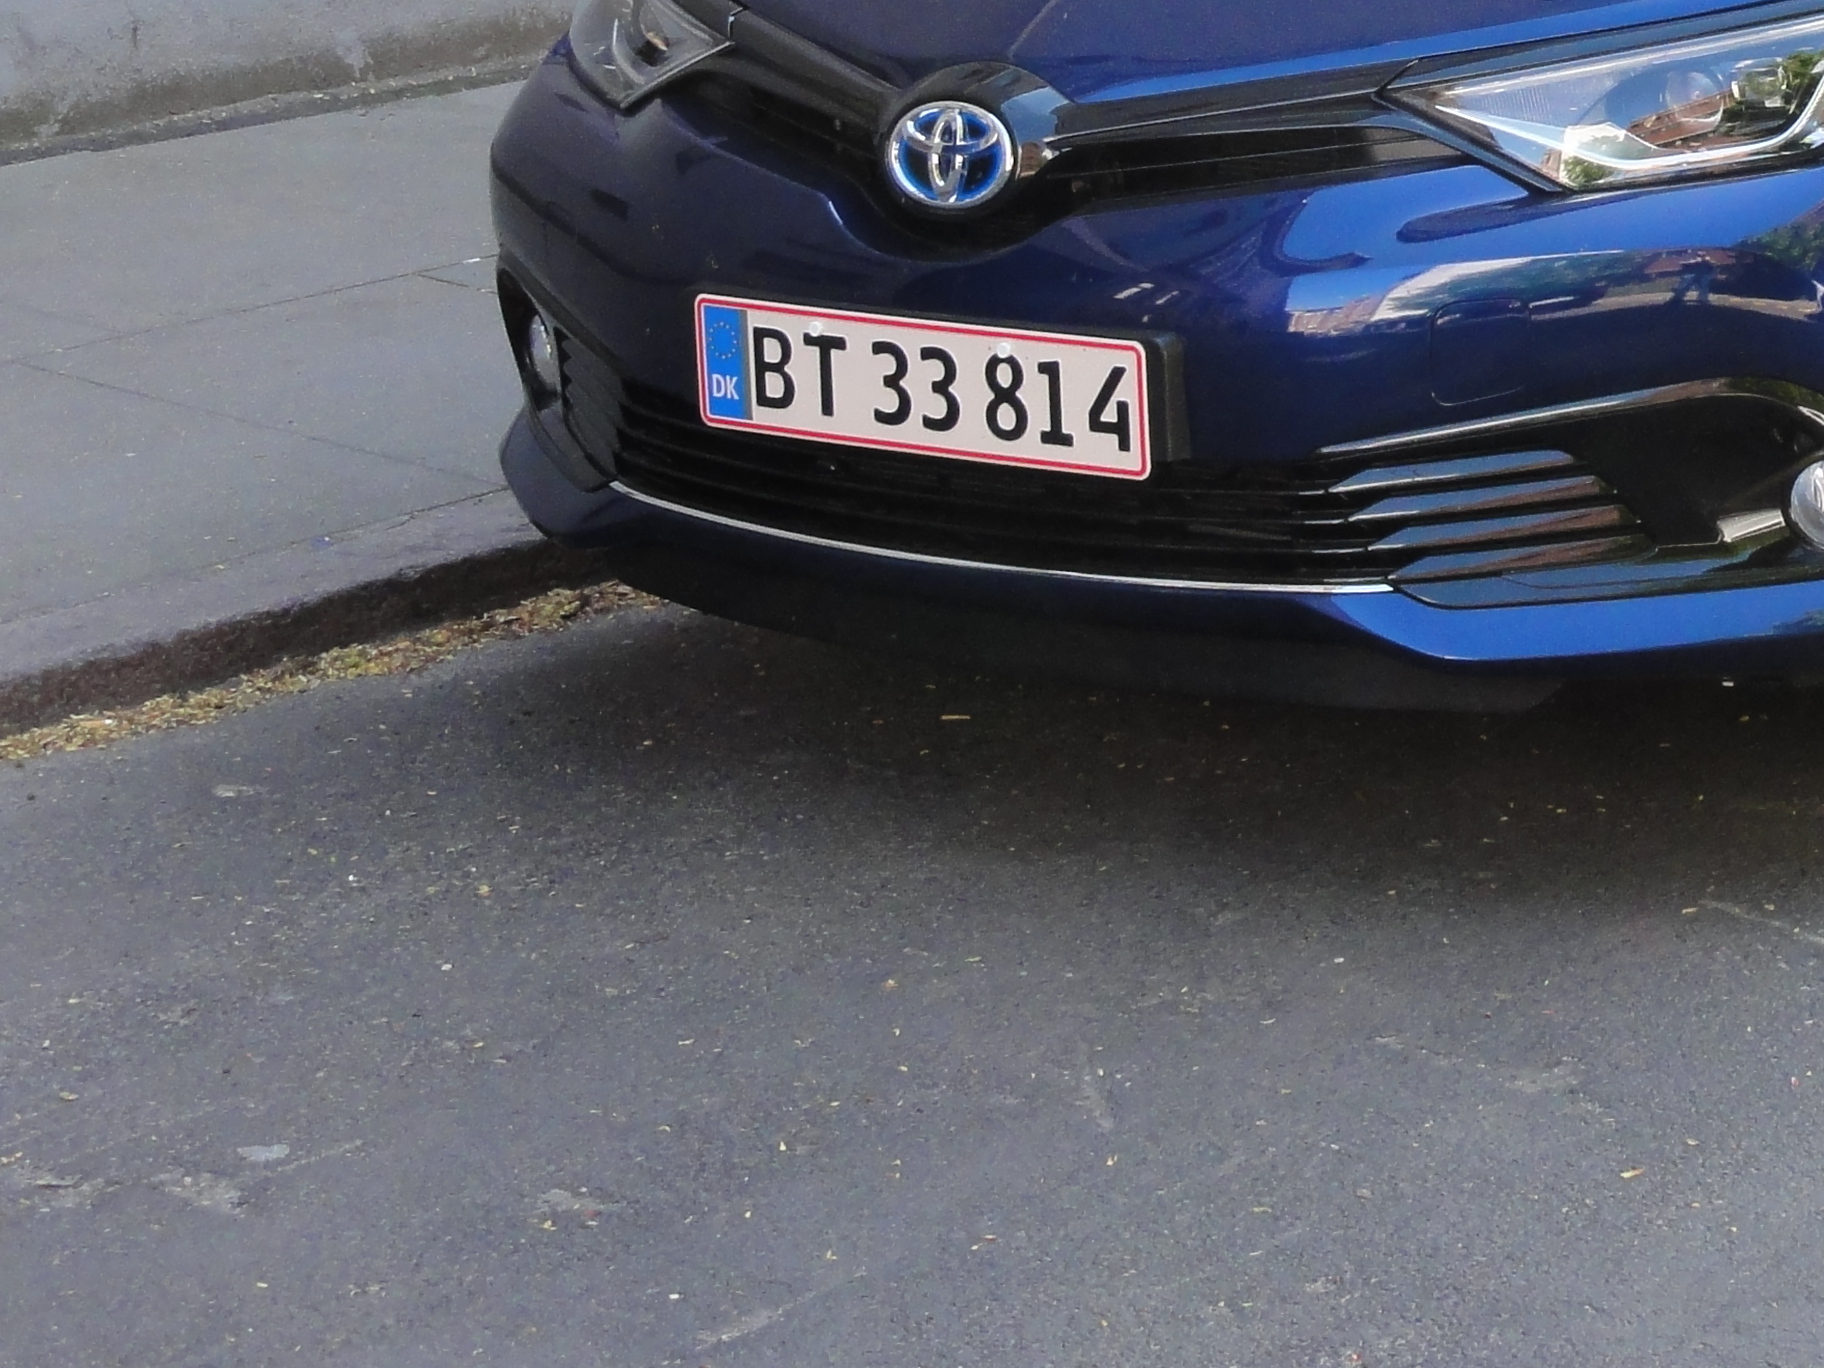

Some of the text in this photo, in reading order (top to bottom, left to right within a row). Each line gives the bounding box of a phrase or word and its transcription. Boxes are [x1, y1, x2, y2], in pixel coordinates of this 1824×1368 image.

[711, 373, 740, 400] DK
[753, 325, 1132, 453] BT 33 814
